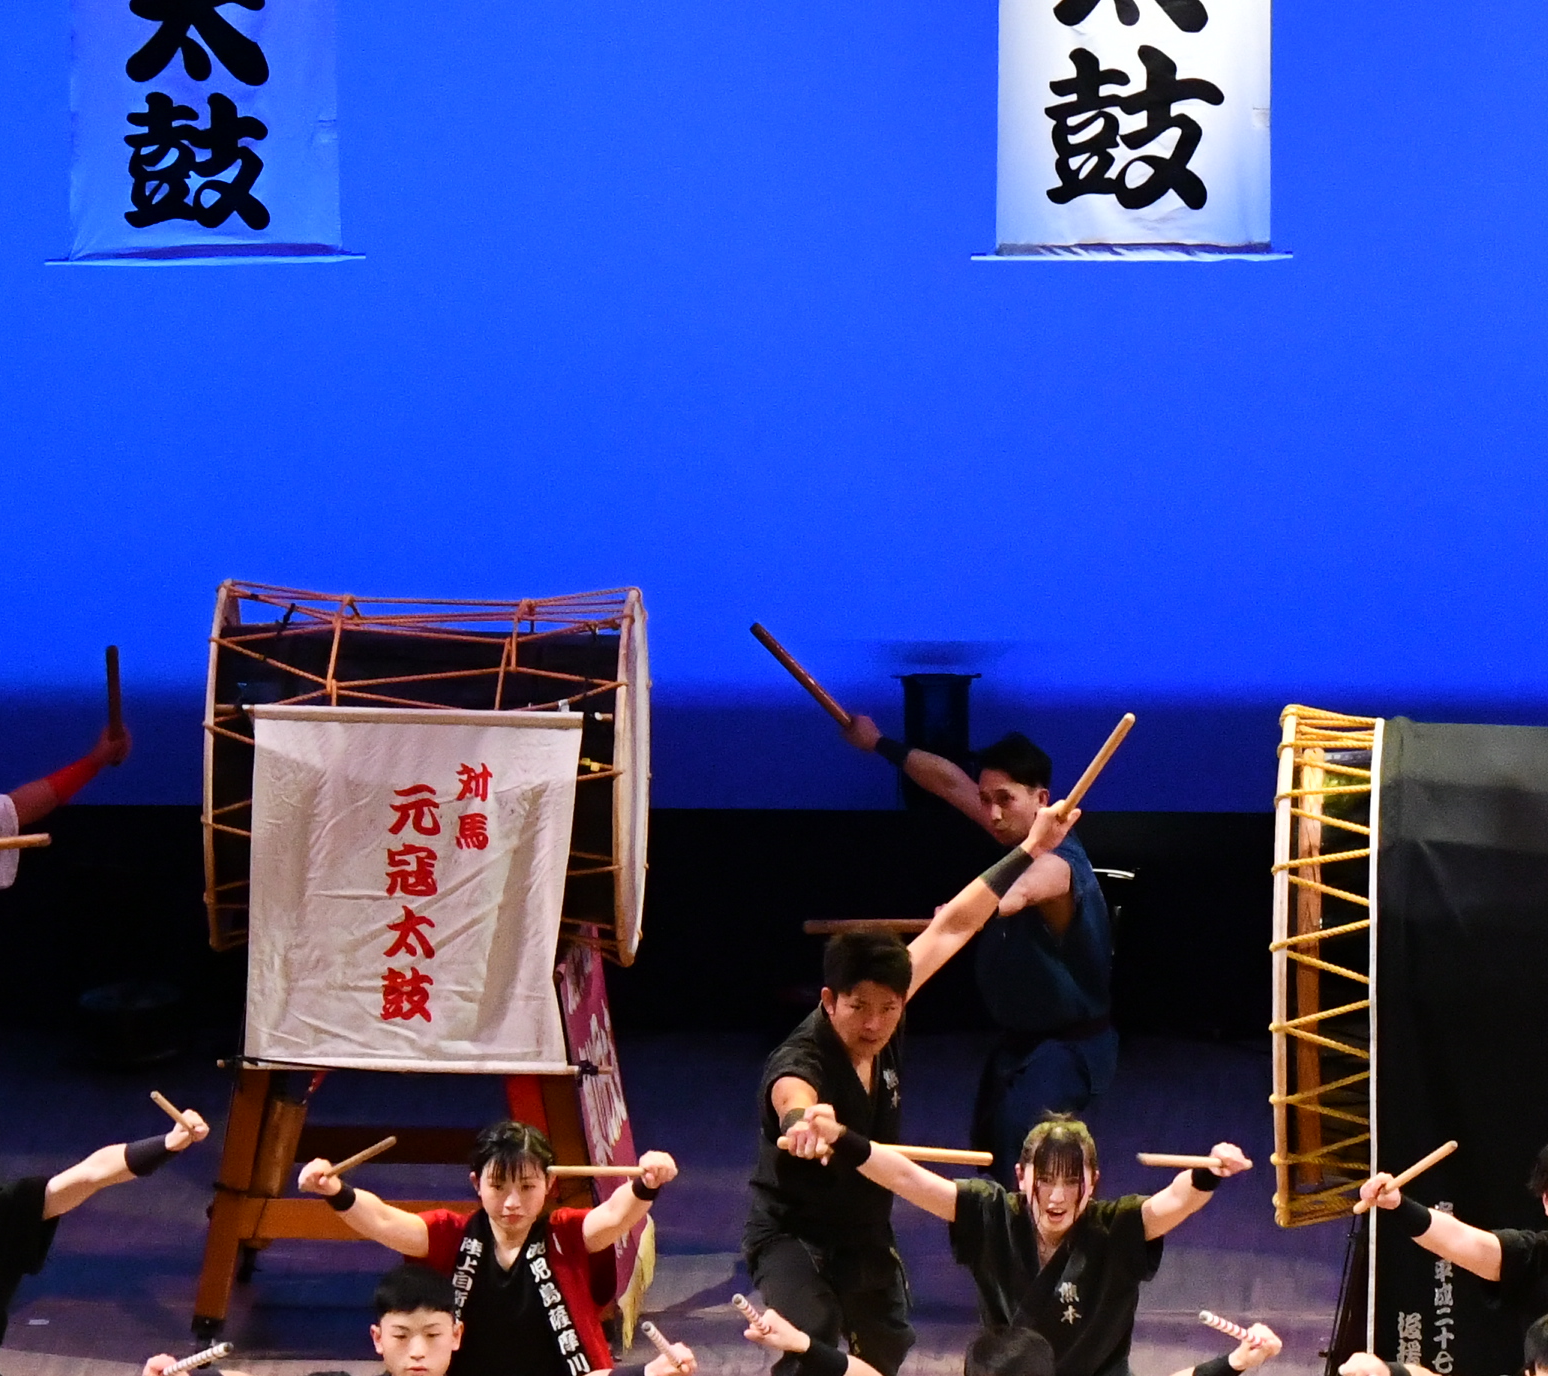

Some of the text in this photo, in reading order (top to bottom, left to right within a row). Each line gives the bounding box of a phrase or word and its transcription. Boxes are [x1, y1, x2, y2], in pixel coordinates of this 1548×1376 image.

[455, 761, 494, 852] 対馬
[380, 782, 441, 1023] 元寇太鼓
